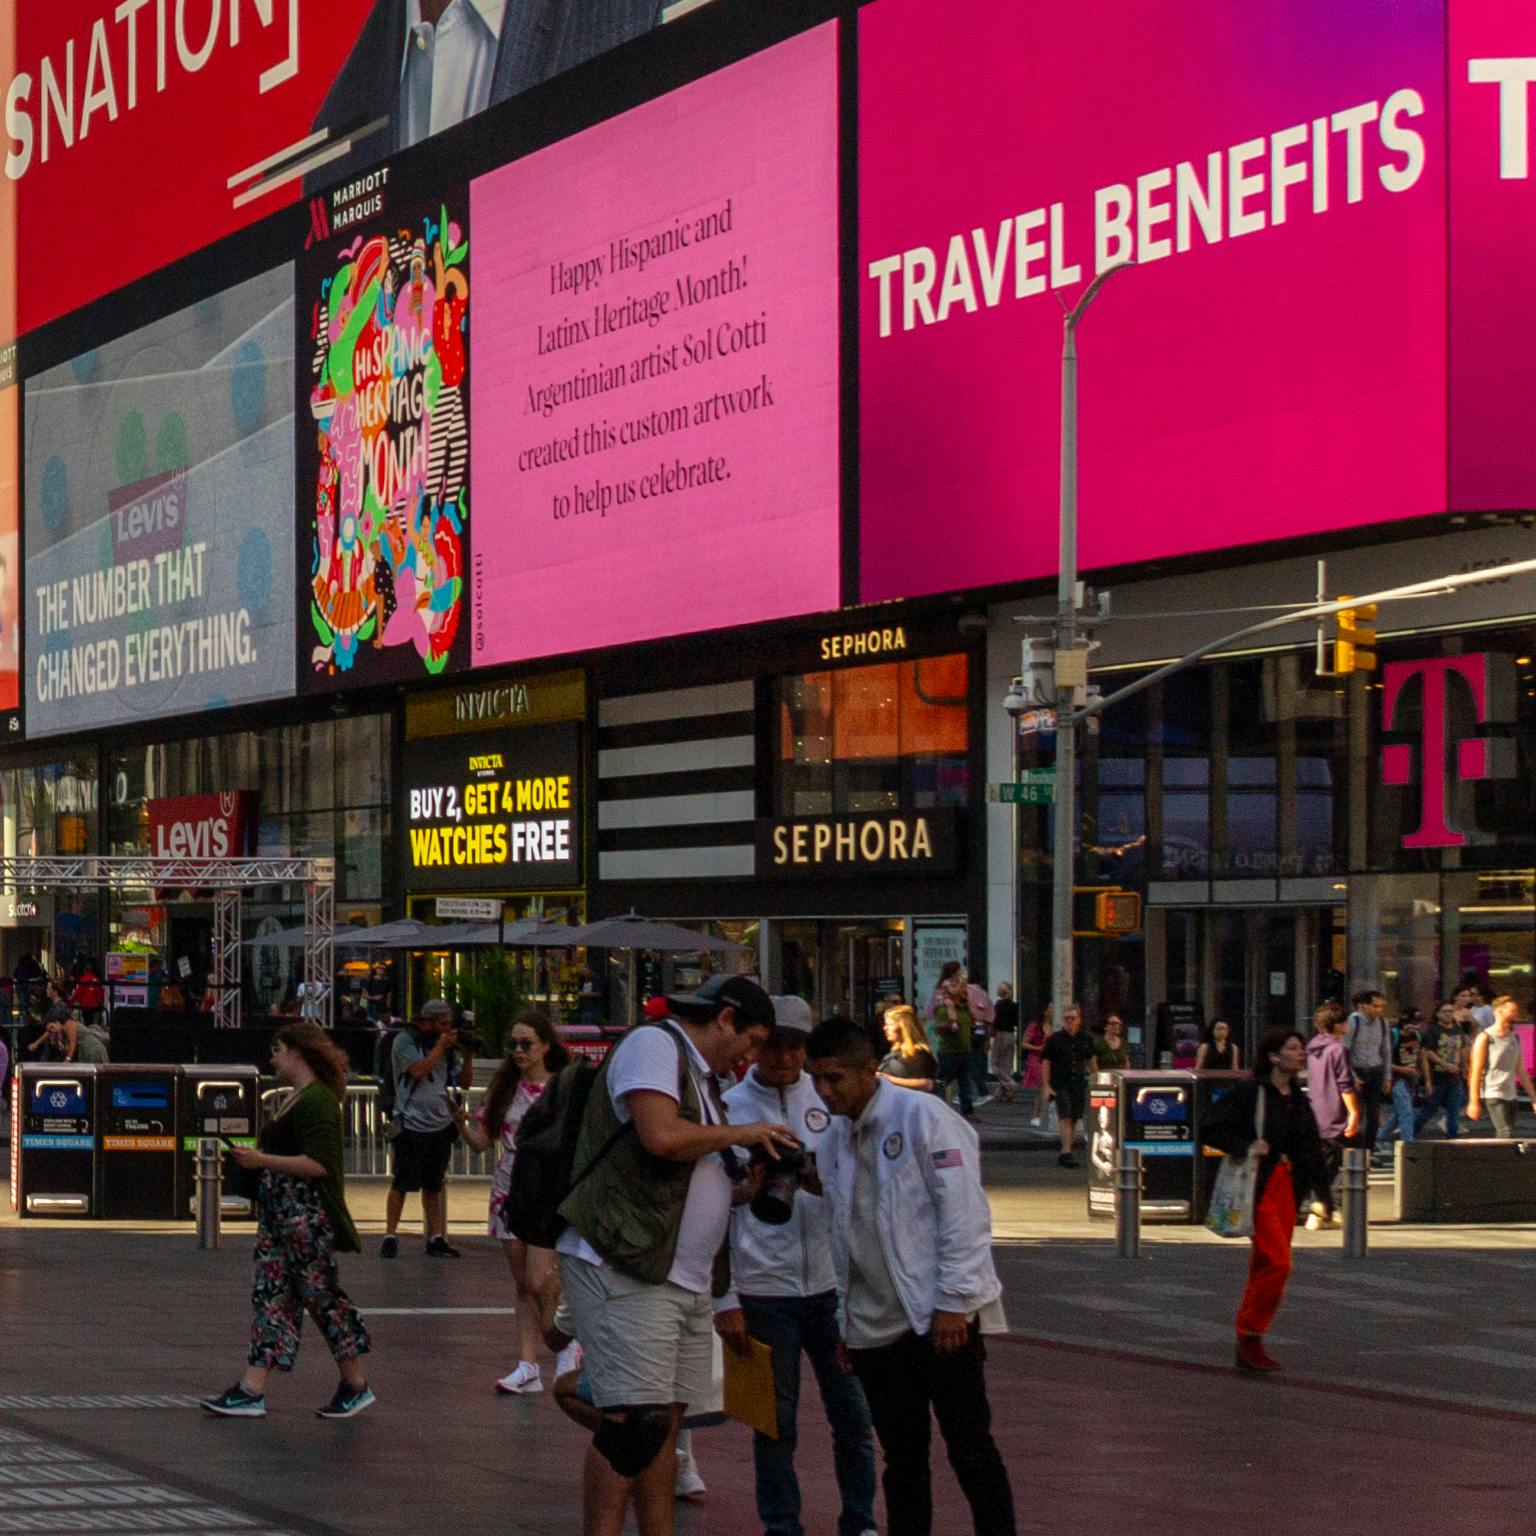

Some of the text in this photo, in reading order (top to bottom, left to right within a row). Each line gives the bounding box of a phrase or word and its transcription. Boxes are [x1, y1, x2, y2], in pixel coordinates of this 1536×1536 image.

[332, 167, 389, 207] MARRIOTT
[332, 194, 383, 231] MARQUIS
[868, 87, 1426, 339] TRAVEL BENEFITS
[550, 198, 733, 296] Happy Hispanic and
[538, 255, 749, 356] Latinx Heritage Month!
[524, 311, 768, 418] Argentinian artist Sol Cotti
[518, 374, 775, 473] created this custom artwork
[356, 425, 428, 510] MONTH
[552, 454, 732, 520] to help us celebrate.
[36, 543, 207, 635] THE NUMBER THAT
[36, 607, 258, 704] CHANGED EVERYTHING.
[820, 627, 907, 661] SEPHORA
[455, 683, 529, 721] INVICTA
[469, 754, 504, 771] INVICTA
[410, 775, 571, 823] BUY 2, GET 4 MORE
[1020, 786, 1039, 801] 46
[409, 819, 571, 867] WATCHES FREE
[772, 818, 932, 864] SEPHORA
[23, 1137, 95, 1148] TIMES SQUARE
[104, 1138, 135, 1148] TIMES
[136, 1138, 176, 1148] SQUARE
